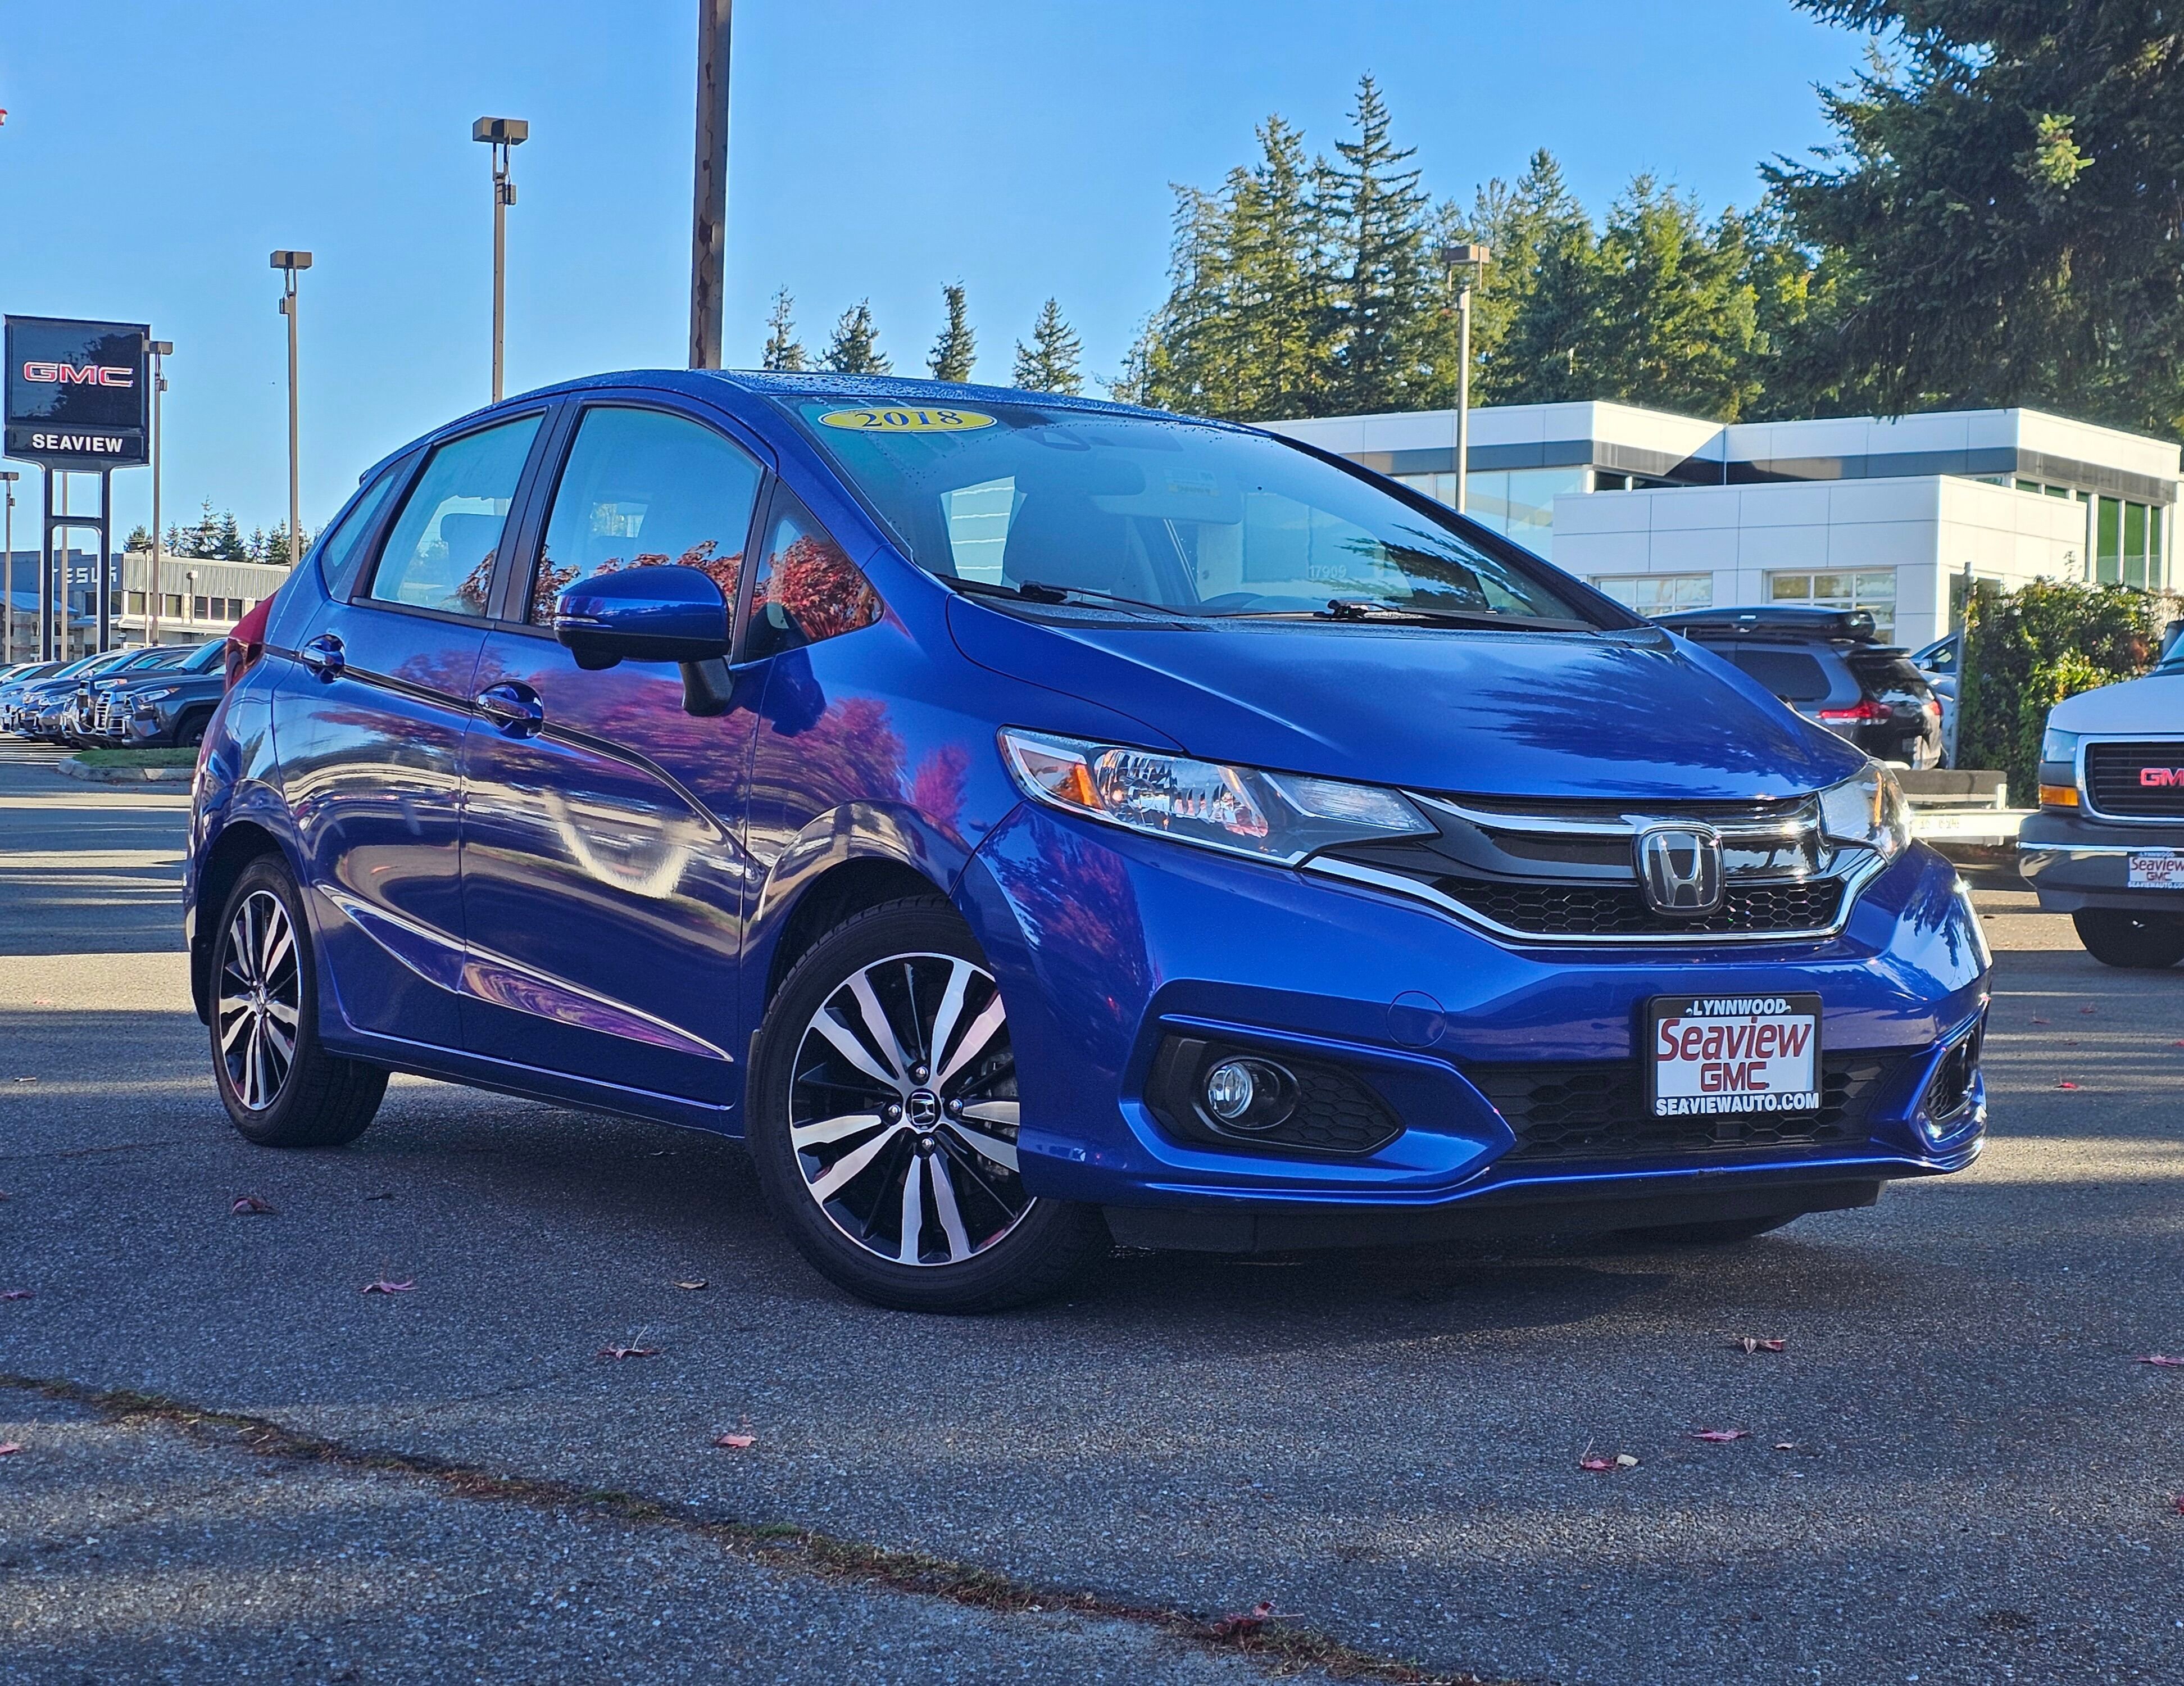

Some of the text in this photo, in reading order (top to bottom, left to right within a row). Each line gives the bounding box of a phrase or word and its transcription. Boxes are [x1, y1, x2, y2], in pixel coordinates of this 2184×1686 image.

[24, 361, 133, 388] GMC
[855, 410, 964, 428] 2018
[32, 433, 123, 453] SEAVIEW
[53, 566, 117, 583] ESL
[2131, 857, 2184, 871] Seaview
[2147, 872, 2172, 881] GMC
[1692, 998, 1787, 1016] LYNNWOOD
[1657, 1016, 1812, 1061] Seaview
[1700, 1062, 1769, 1092] GMC
[1655, 1093, 1820, 1116] SEAVIEWAUTO.COM
